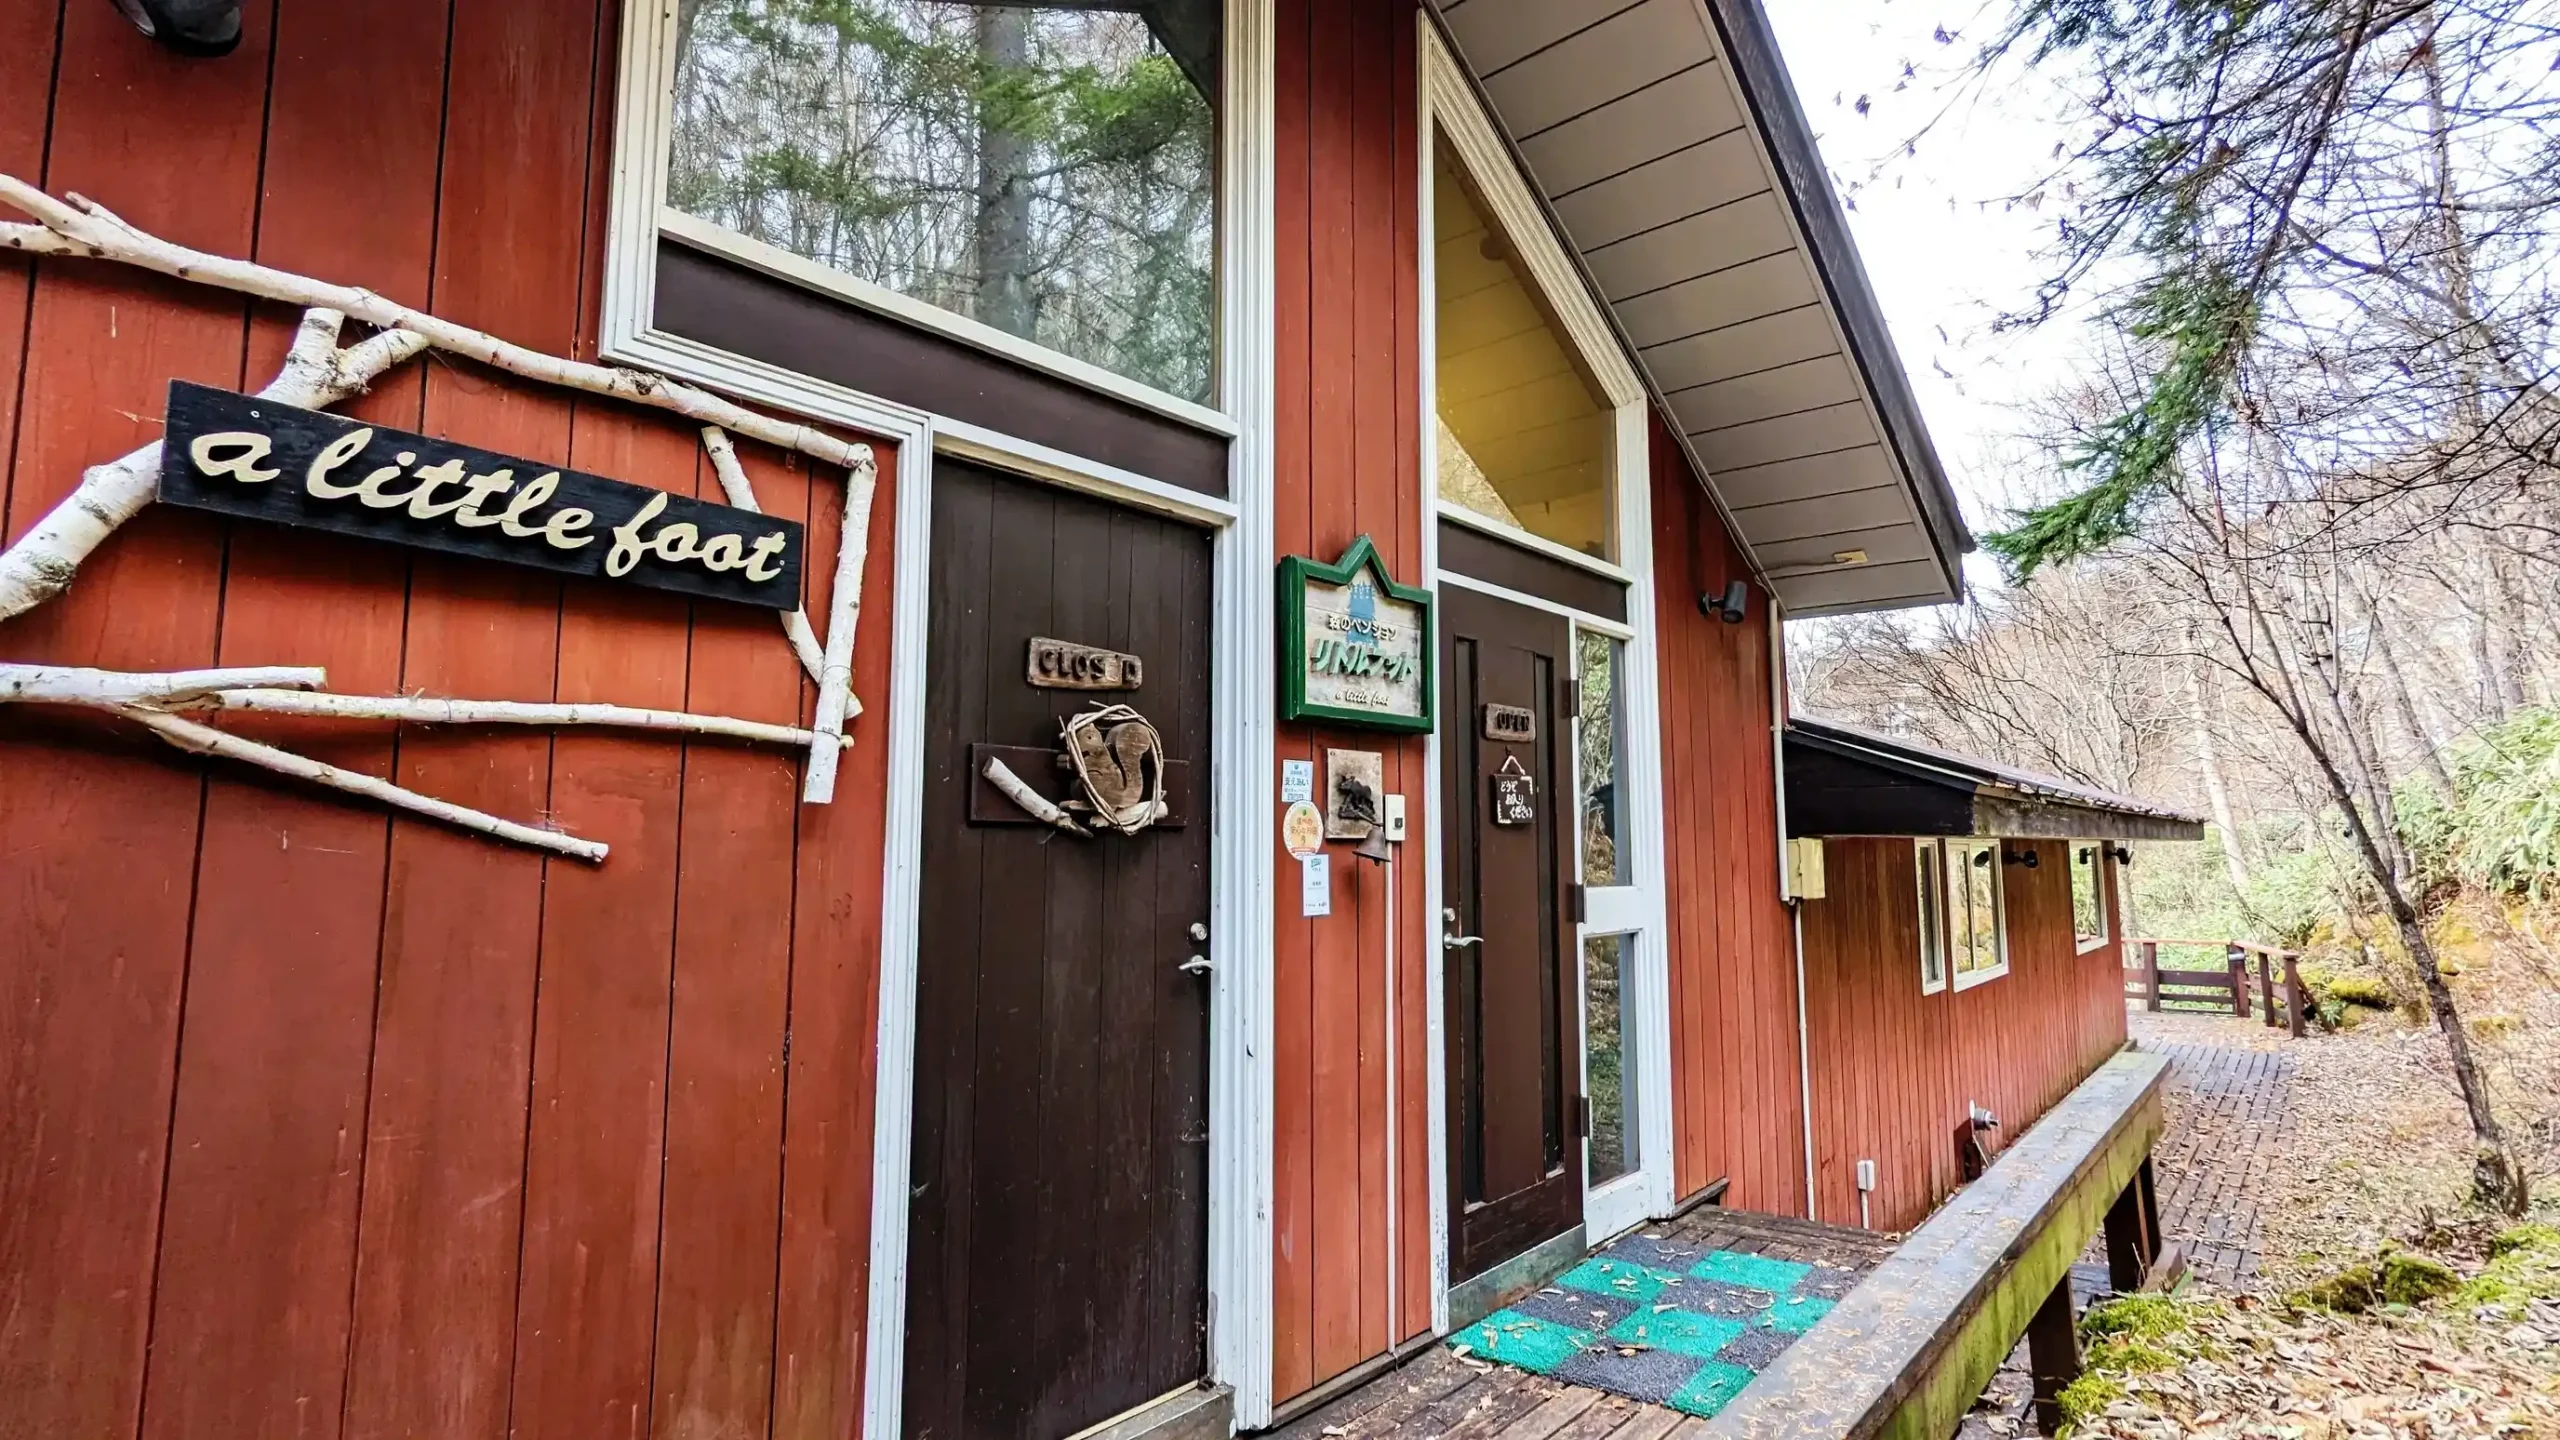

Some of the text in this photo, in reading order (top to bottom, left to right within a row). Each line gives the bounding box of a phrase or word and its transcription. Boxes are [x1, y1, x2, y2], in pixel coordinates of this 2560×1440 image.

[190, 427, 787, 582] a little foot
[1327, 613, 1397, 640] 森のペンション
[1310, 638, 1417, 683] リトルフット
[1345, 688, 1368, 704] little
[1496, 711, 1530, 733] OPEN
[1500, 780, 1518, 793] どうぞ
[1509, 805, 1533, 819] ください
